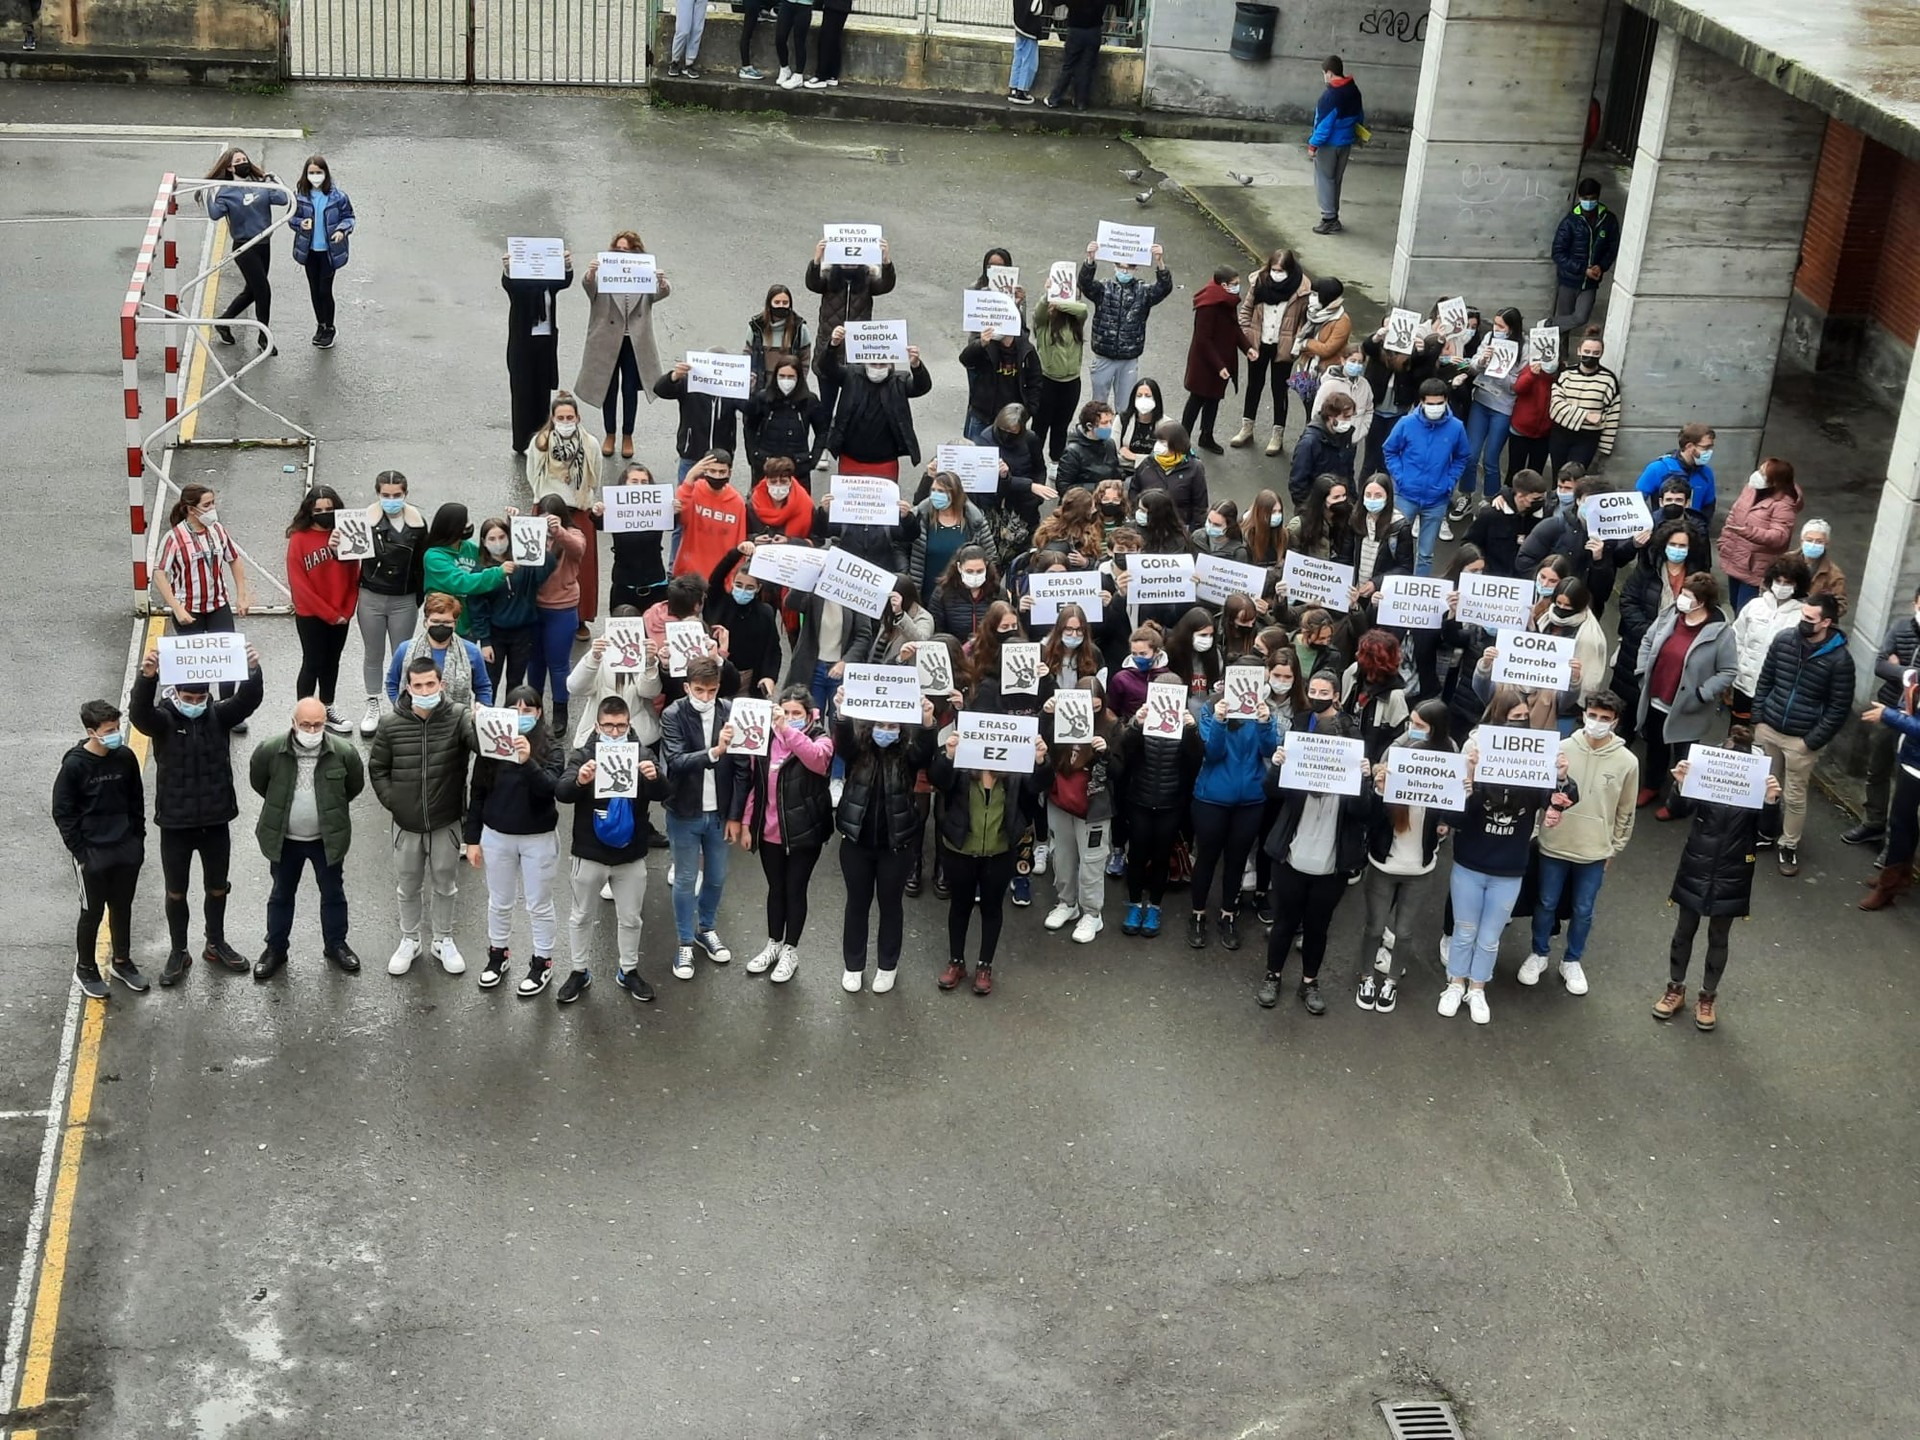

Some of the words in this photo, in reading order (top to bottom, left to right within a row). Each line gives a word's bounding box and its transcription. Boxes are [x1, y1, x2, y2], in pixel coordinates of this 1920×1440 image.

[845, 247, 862, 256] EZ
[602, 275, 651, 284] BORTZATZEN
[853, 333, 898, 341] BORROKA
[692, 375, 745, 388] BORTZATZEN
[616, 490, 662, 505] LIBRE
[1600, 496, 1633, 508] GORA
[616, 510, 634, 518] BIZI
[636, 509, 662, 518] NAHI
[1599, 511, 1639, 522] borroka
[625, 520, 654, 529] DUGU
[1597, 524, 1644, 536] feminista
[1141, 559, 1180, 568] GORA
[1303, 559, 1333, 572] Gaurko
[836, 558, 883, 588] LIBRE
[1292, 567, 1342, 584] BORROKA
[1048, 578, 1083, 587] ERASO
[1141, 574, 1182, 585] borroka
[1036, 588, 1097, 598] SEXISTARIK
[1300, 581, 1331, 593] biharko
[1394, 581, 1442, 599] LIBRE
[1471, 582, 1520, 600] LIBRE
[820, 583, 832, 594] EZ
[833, 588, 879, 612] AUSARTA
[1137, 588, 1186, 599] feminista
[1290, 588, 1326, 603] BIZITZA
[1329, 599, 1339, 607] da
[1393, 601, 1411, 611] BIZI
[1412, 603, 1439, 613] NAHI
[1466, 600, 1483, 608] IZAN
[1400, 614, 1429, 625] DUGU
[1462, 608, 1474, 617] EZ
[1476, 612, 1523, 625] AUSARTA
[175, 637, 231, 650] LIBRE
[1513, 636, 1557, 652] GORA
[176, 656, 197, 665] BIZI
[200, 654, 231, 664] NAHI
[1509, 653, 1556, 669] borroka
[187, 668, 223, 679] DUGU
[849, 672, 871, 681] Hezi
[873, 674, 916, 685] dezagun
[1503, 668, 1558, 684] feminista
[876, 687, 888, 695] EZ
[847, 698, 915, 709] BORTZATZEN
[979, 721, 1017, 731] ERASO
[963, 731, 1031, 744] SEXISTARIK
[1297, 735, 1331, 745] ZARATAN
[1492, 734, 1545, 753] LIBRE
[983, 747, 1008, 760] EZ
[1411, 753, 1446, 764] Gaurko
[1702, 749, 1735, 760] ZARATAN
[1486, 755, 1505, 763] IZAN
[1506, 757, 1527, 766] NAHI
[1707, 759, 1740, 770] HARTZEN
[1295, 770, 1327, 780] HARTZEN
[1398, 764, 1456, 779] BORROKA
[1481, 766, 1494, 776] EZ
[1497, 768, 1550, 781] AUSARTA
[1308, 780, 1330, 789] PARTE
[1407, 778, 1444, 790] biharko
[1698, 782, 1729, 794] HARTZEN
[1395, 790, 1438, 804] BIZITZA
[1440, 797, 1453, 806] da
[1711, 792, 1732, 802] PARTE
